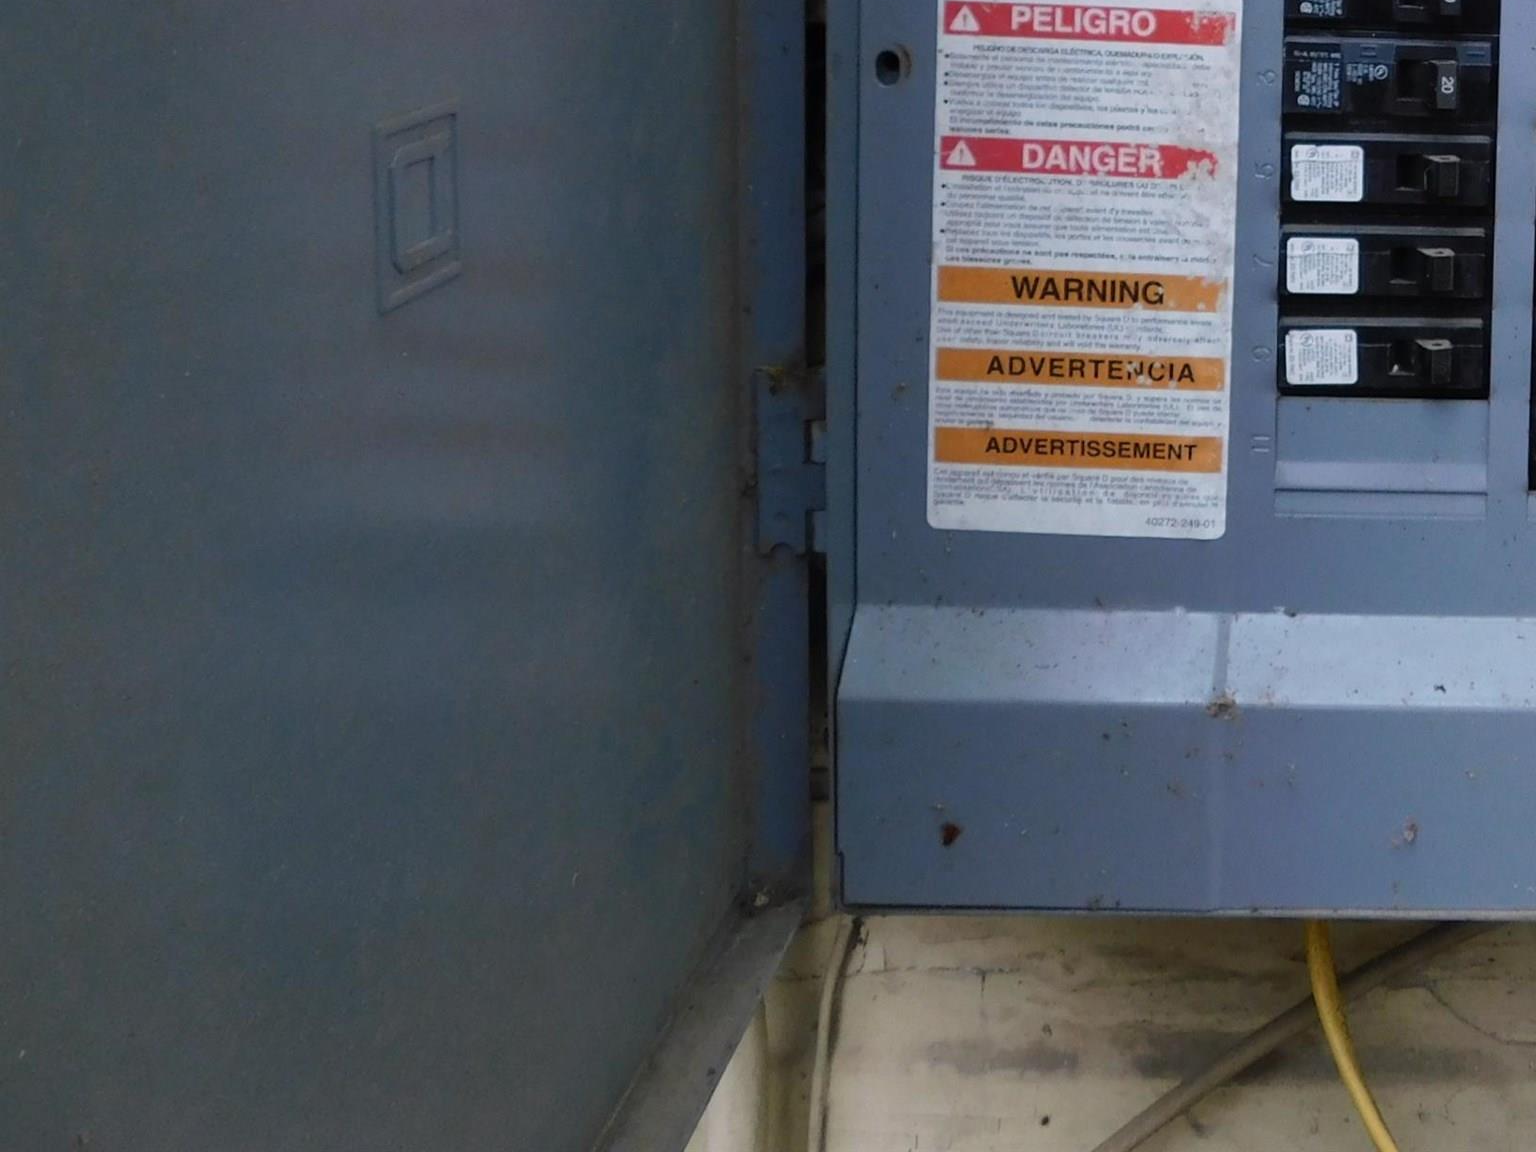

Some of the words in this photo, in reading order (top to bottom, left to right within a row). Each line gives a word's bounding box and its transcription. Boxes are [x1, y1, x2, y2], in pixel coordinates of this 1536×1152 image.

[1010, 5, 1157, 37] PELIGRO
[1441, 76, 1454, 95] 20
[1022, 142, 1163, 178] DANGER
[1011, 275, 1165, 306] WARNING
[987, 355, 1195, 383] ADVERTENCIA
[985, 436, 1198, 461] ADVERTISSEMENT
